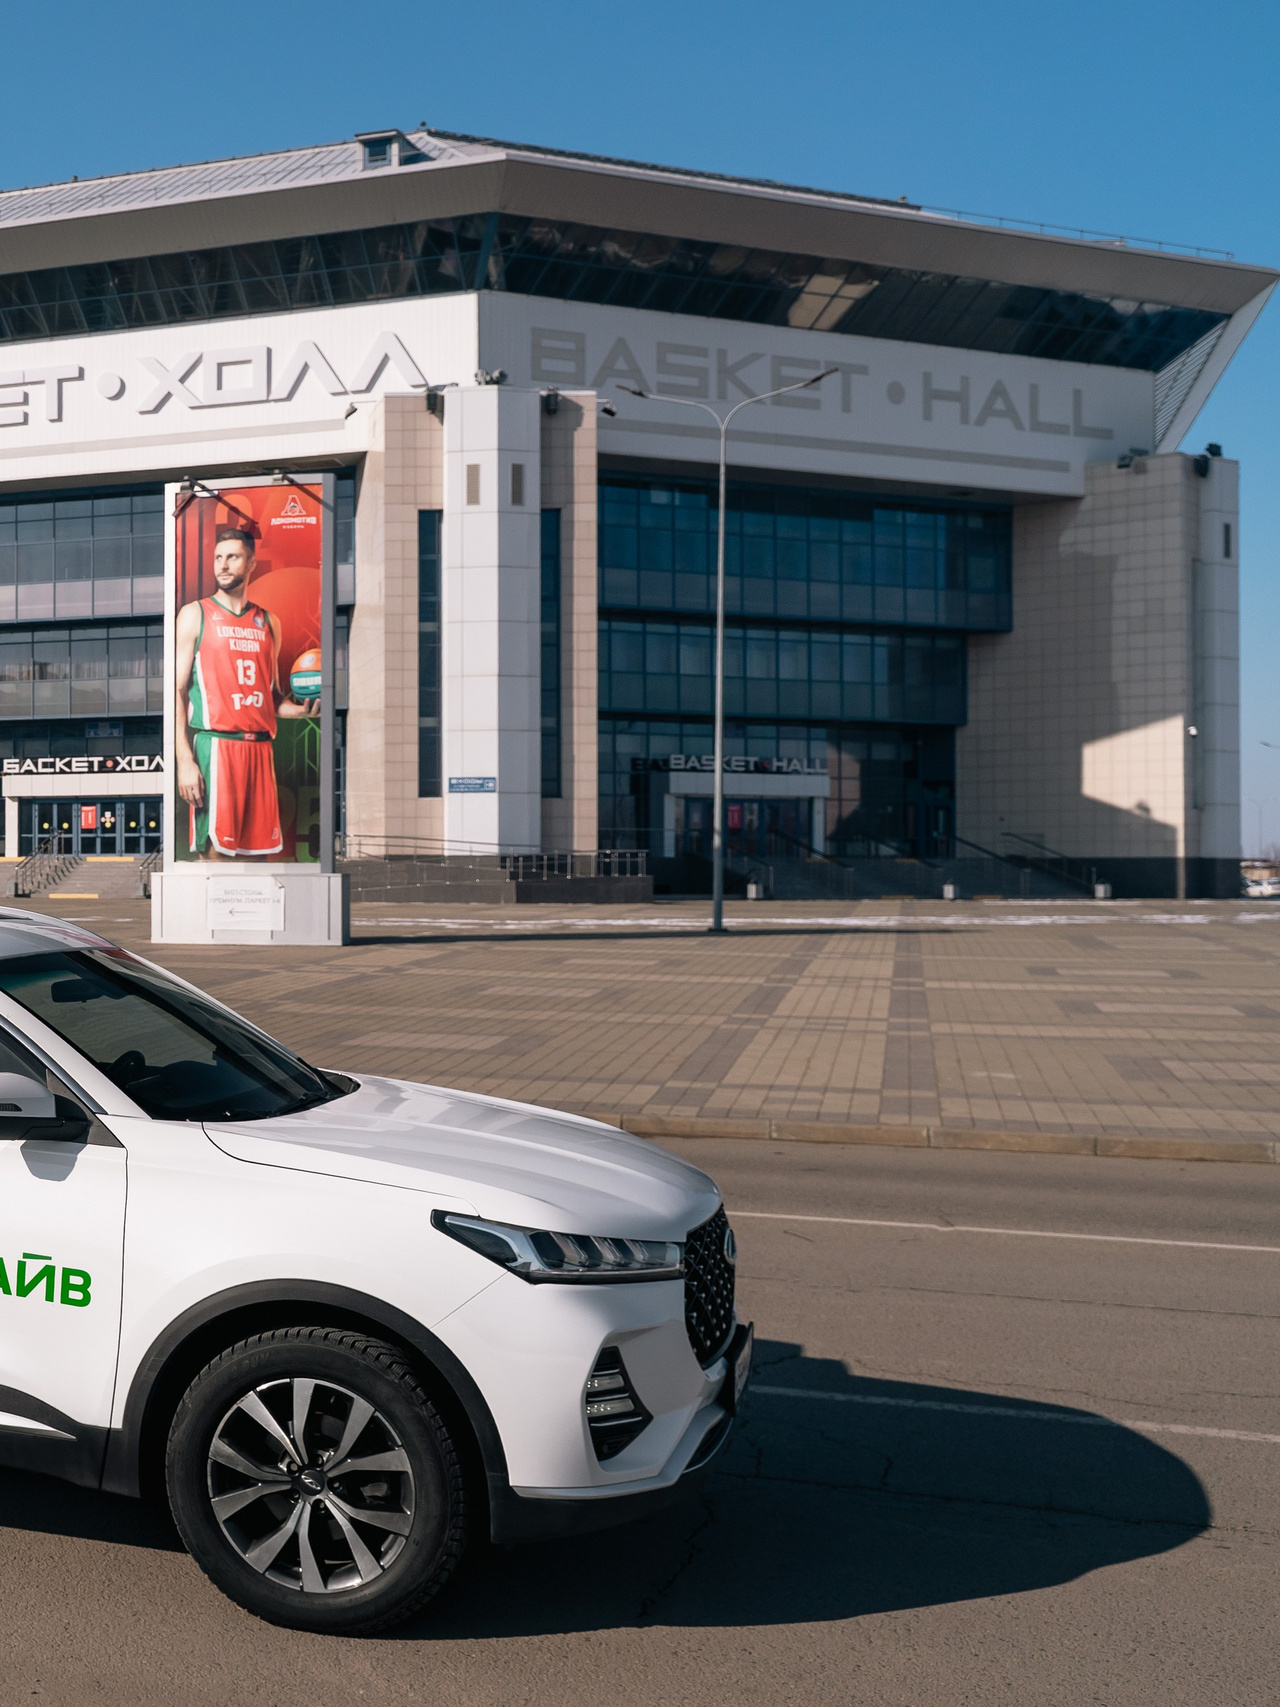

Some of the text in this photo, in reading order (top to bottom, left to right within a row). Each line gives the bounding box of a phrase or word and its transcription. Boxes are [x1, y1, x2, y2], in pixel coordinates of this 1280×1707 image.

[137, 331, 429, 415] ХОЛЛ
[531, 326, 1114, 440] BASKET HALL
[216, 626, 265, 642] LOKOMOTIV
[229, 638, 260, 652] KUBAN
[236, 659, 256, 686] 13
[3, 756, 104, 773] БАСКЕТ
[670, 754, 759, 772] BASKET
[772, 757, 828, 773] HALL
